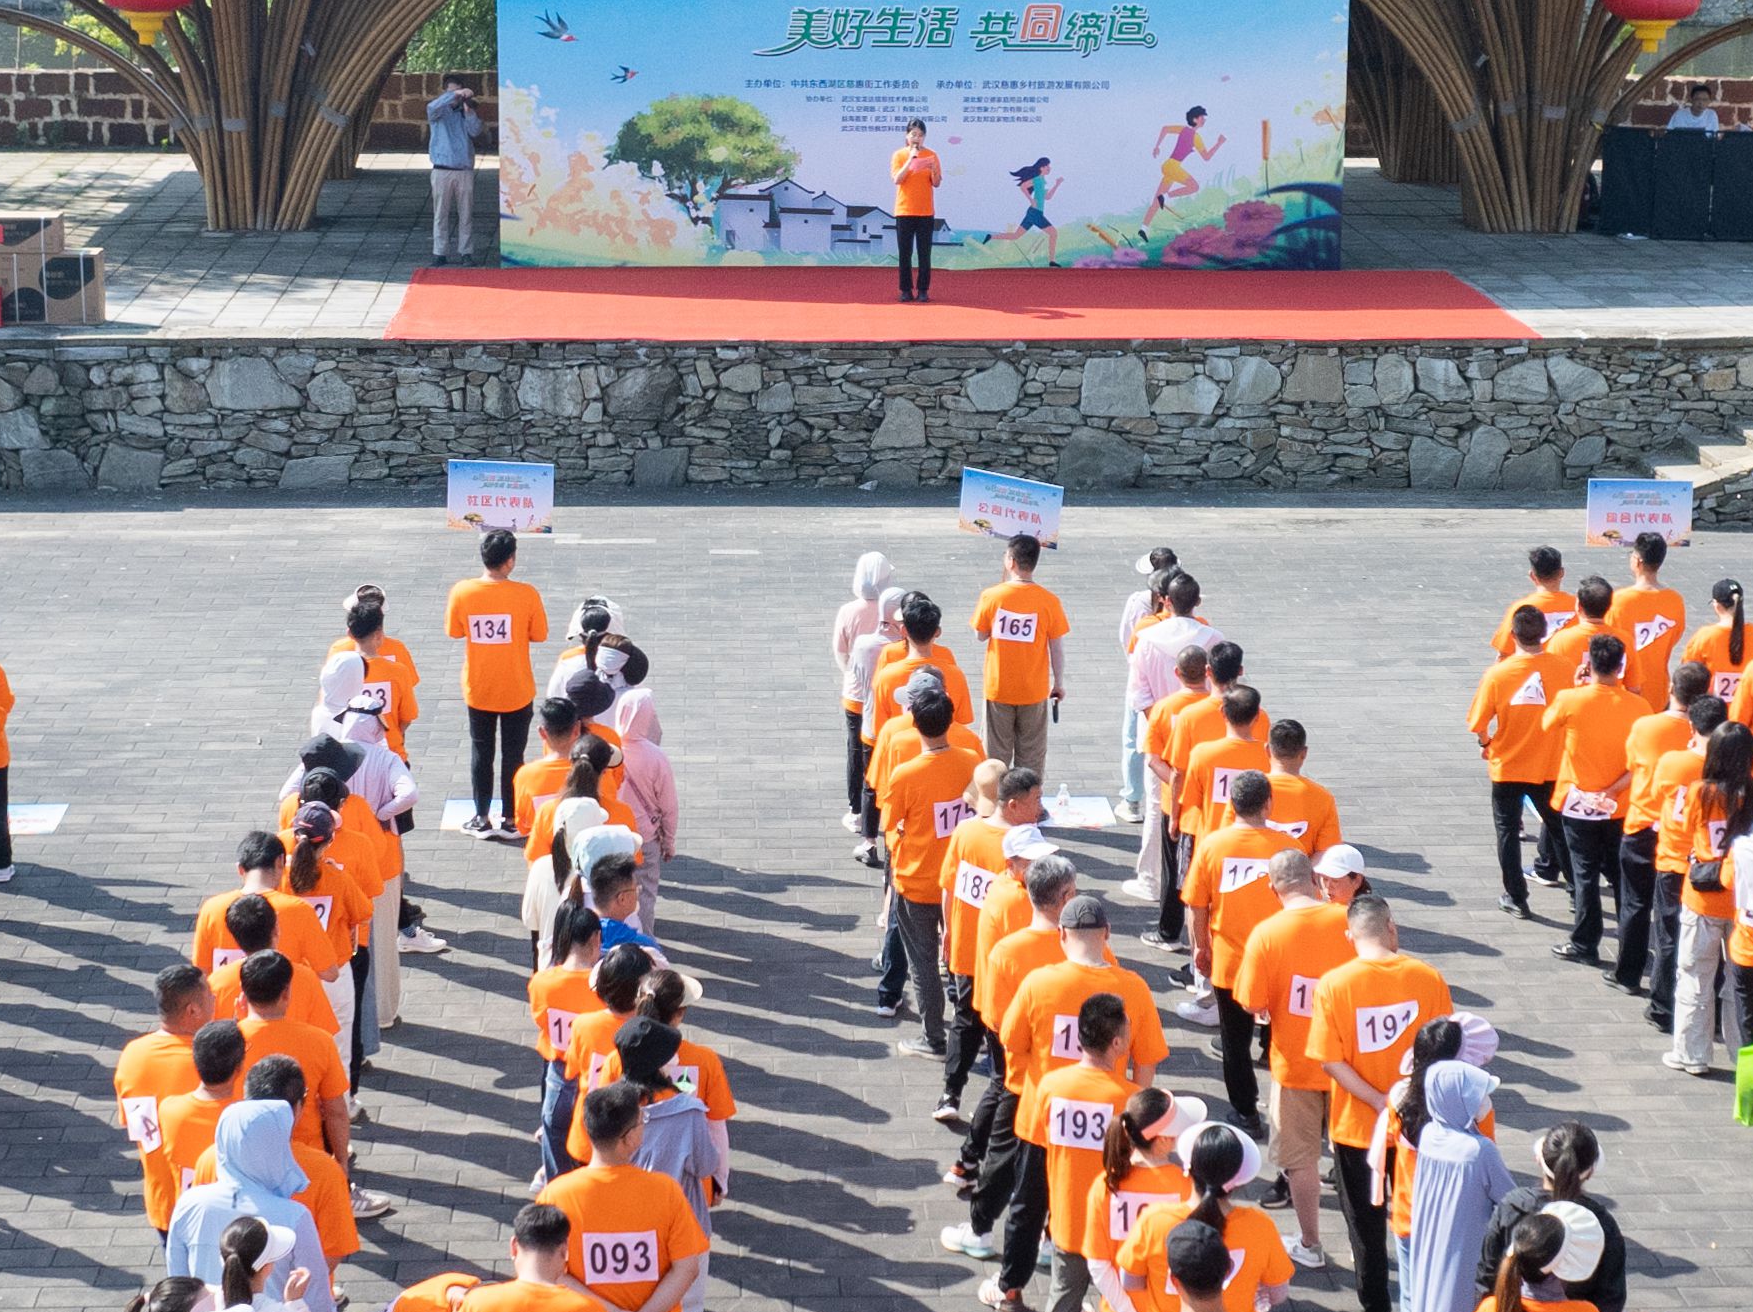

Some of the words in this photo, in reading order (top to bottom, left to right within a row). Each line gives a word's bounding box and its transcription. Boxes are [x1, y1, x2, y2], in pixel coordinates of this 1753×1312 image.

[753, 5, 959, 57] 美好生活
[970, 3, 1159, 58] 共同缔造
[466, 495, 535, 509] 社区代表队
[473, 620, 507, 639] 134
[999, 615, 1032, 637] 165
[1719, 677, 1741, 697] 22
[1056, 1108, 1106, 1141] 193
[590, 1240, 652, 1275] 093
